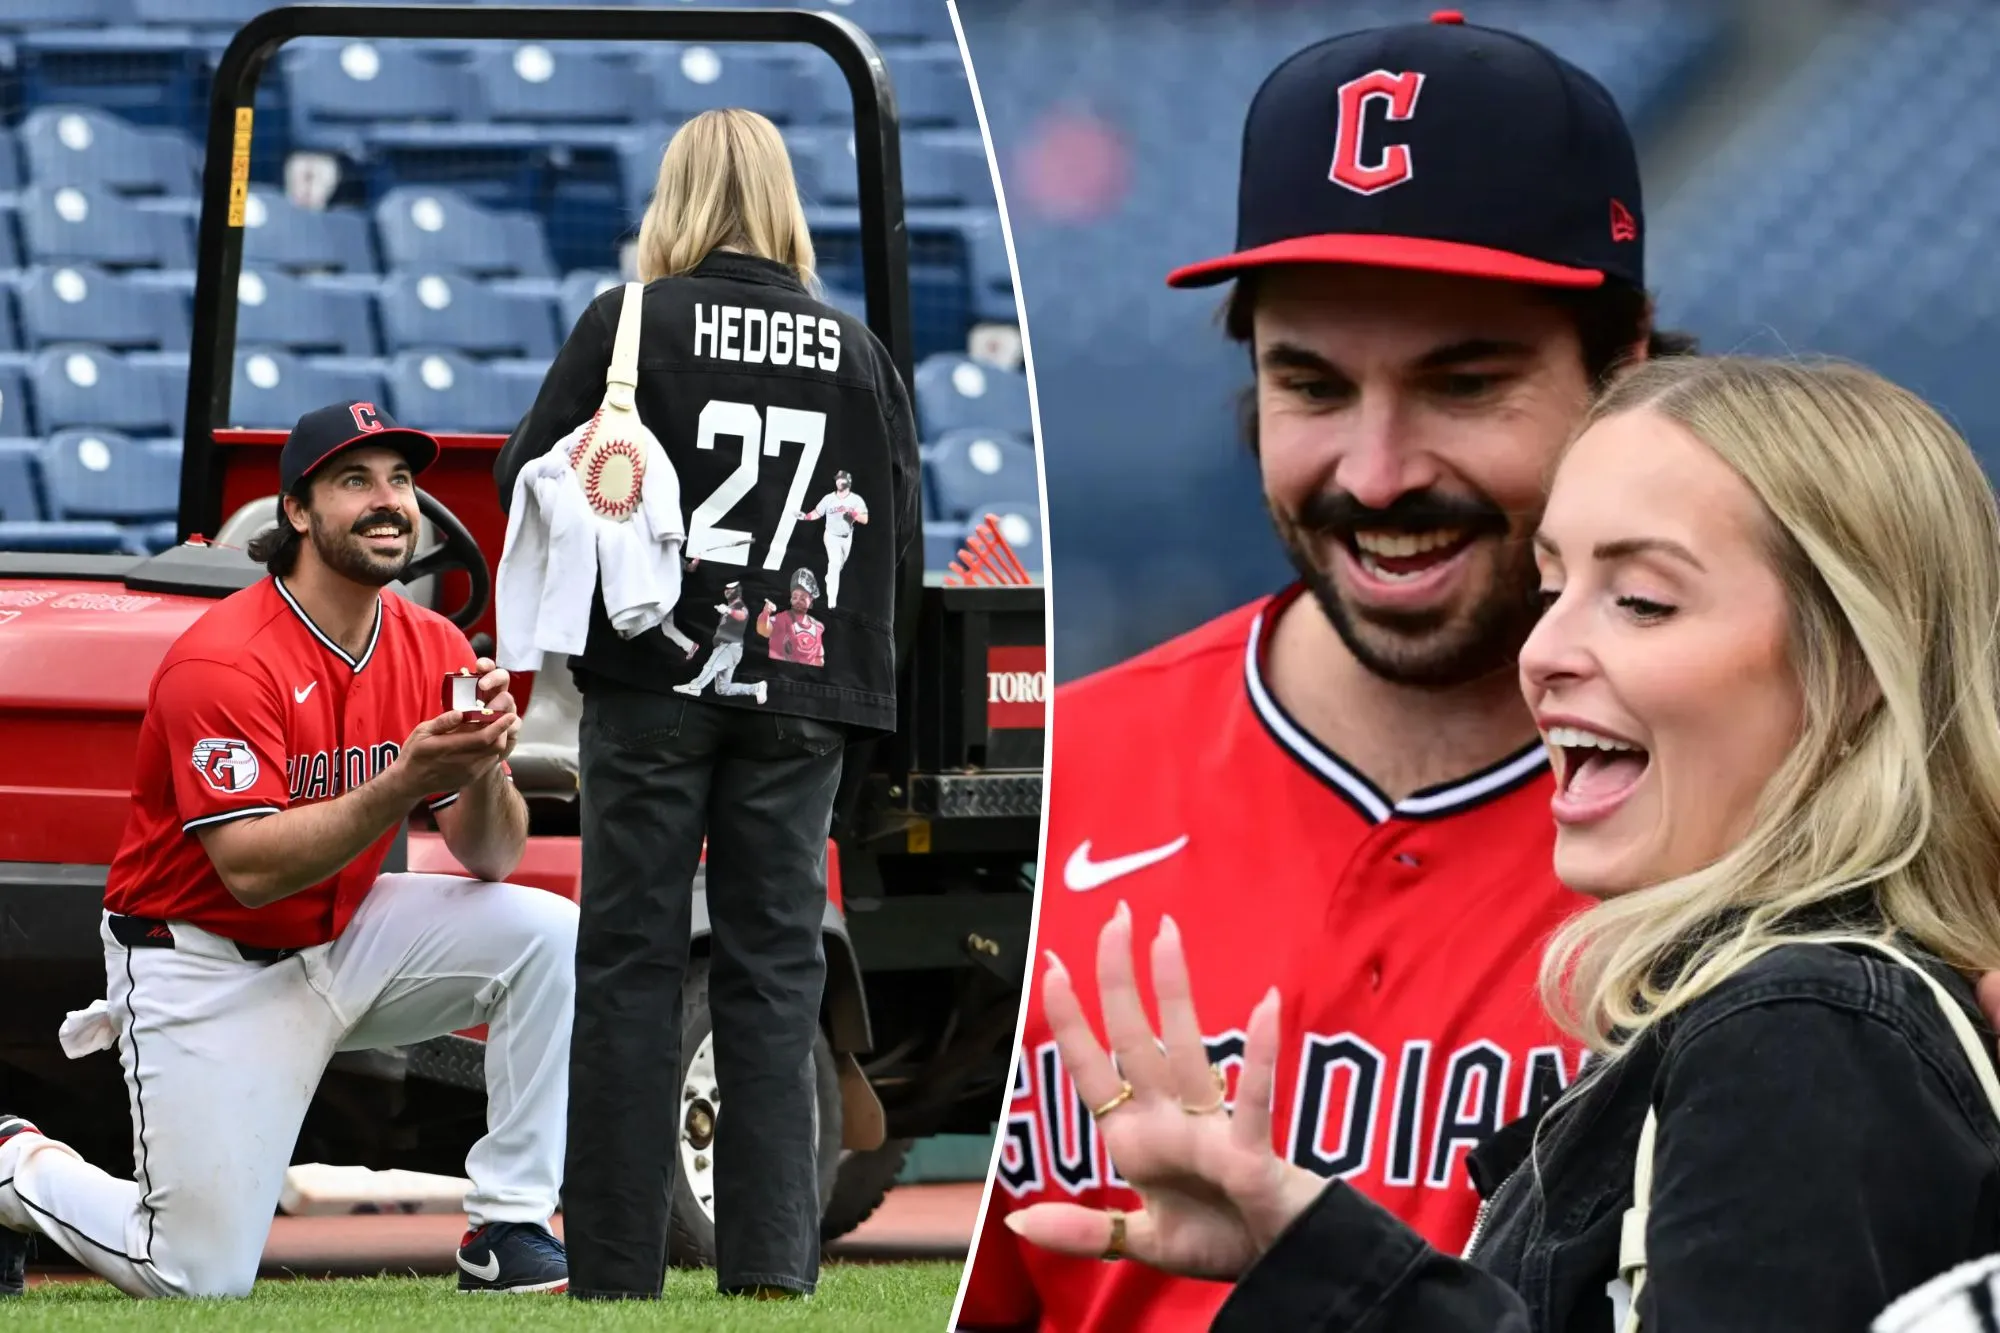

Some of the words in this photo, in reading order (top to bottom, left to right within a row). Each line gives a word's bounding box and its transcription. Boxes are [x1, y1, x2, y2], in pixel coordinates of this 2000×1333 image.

[1327, 69, 1426, 195] C
[694, 302, 841, 373] HEDGES
[349, 401, 385, 433] C
[685, 399, 828, 572] 27
[986, 671, 1046, 704] TORO
